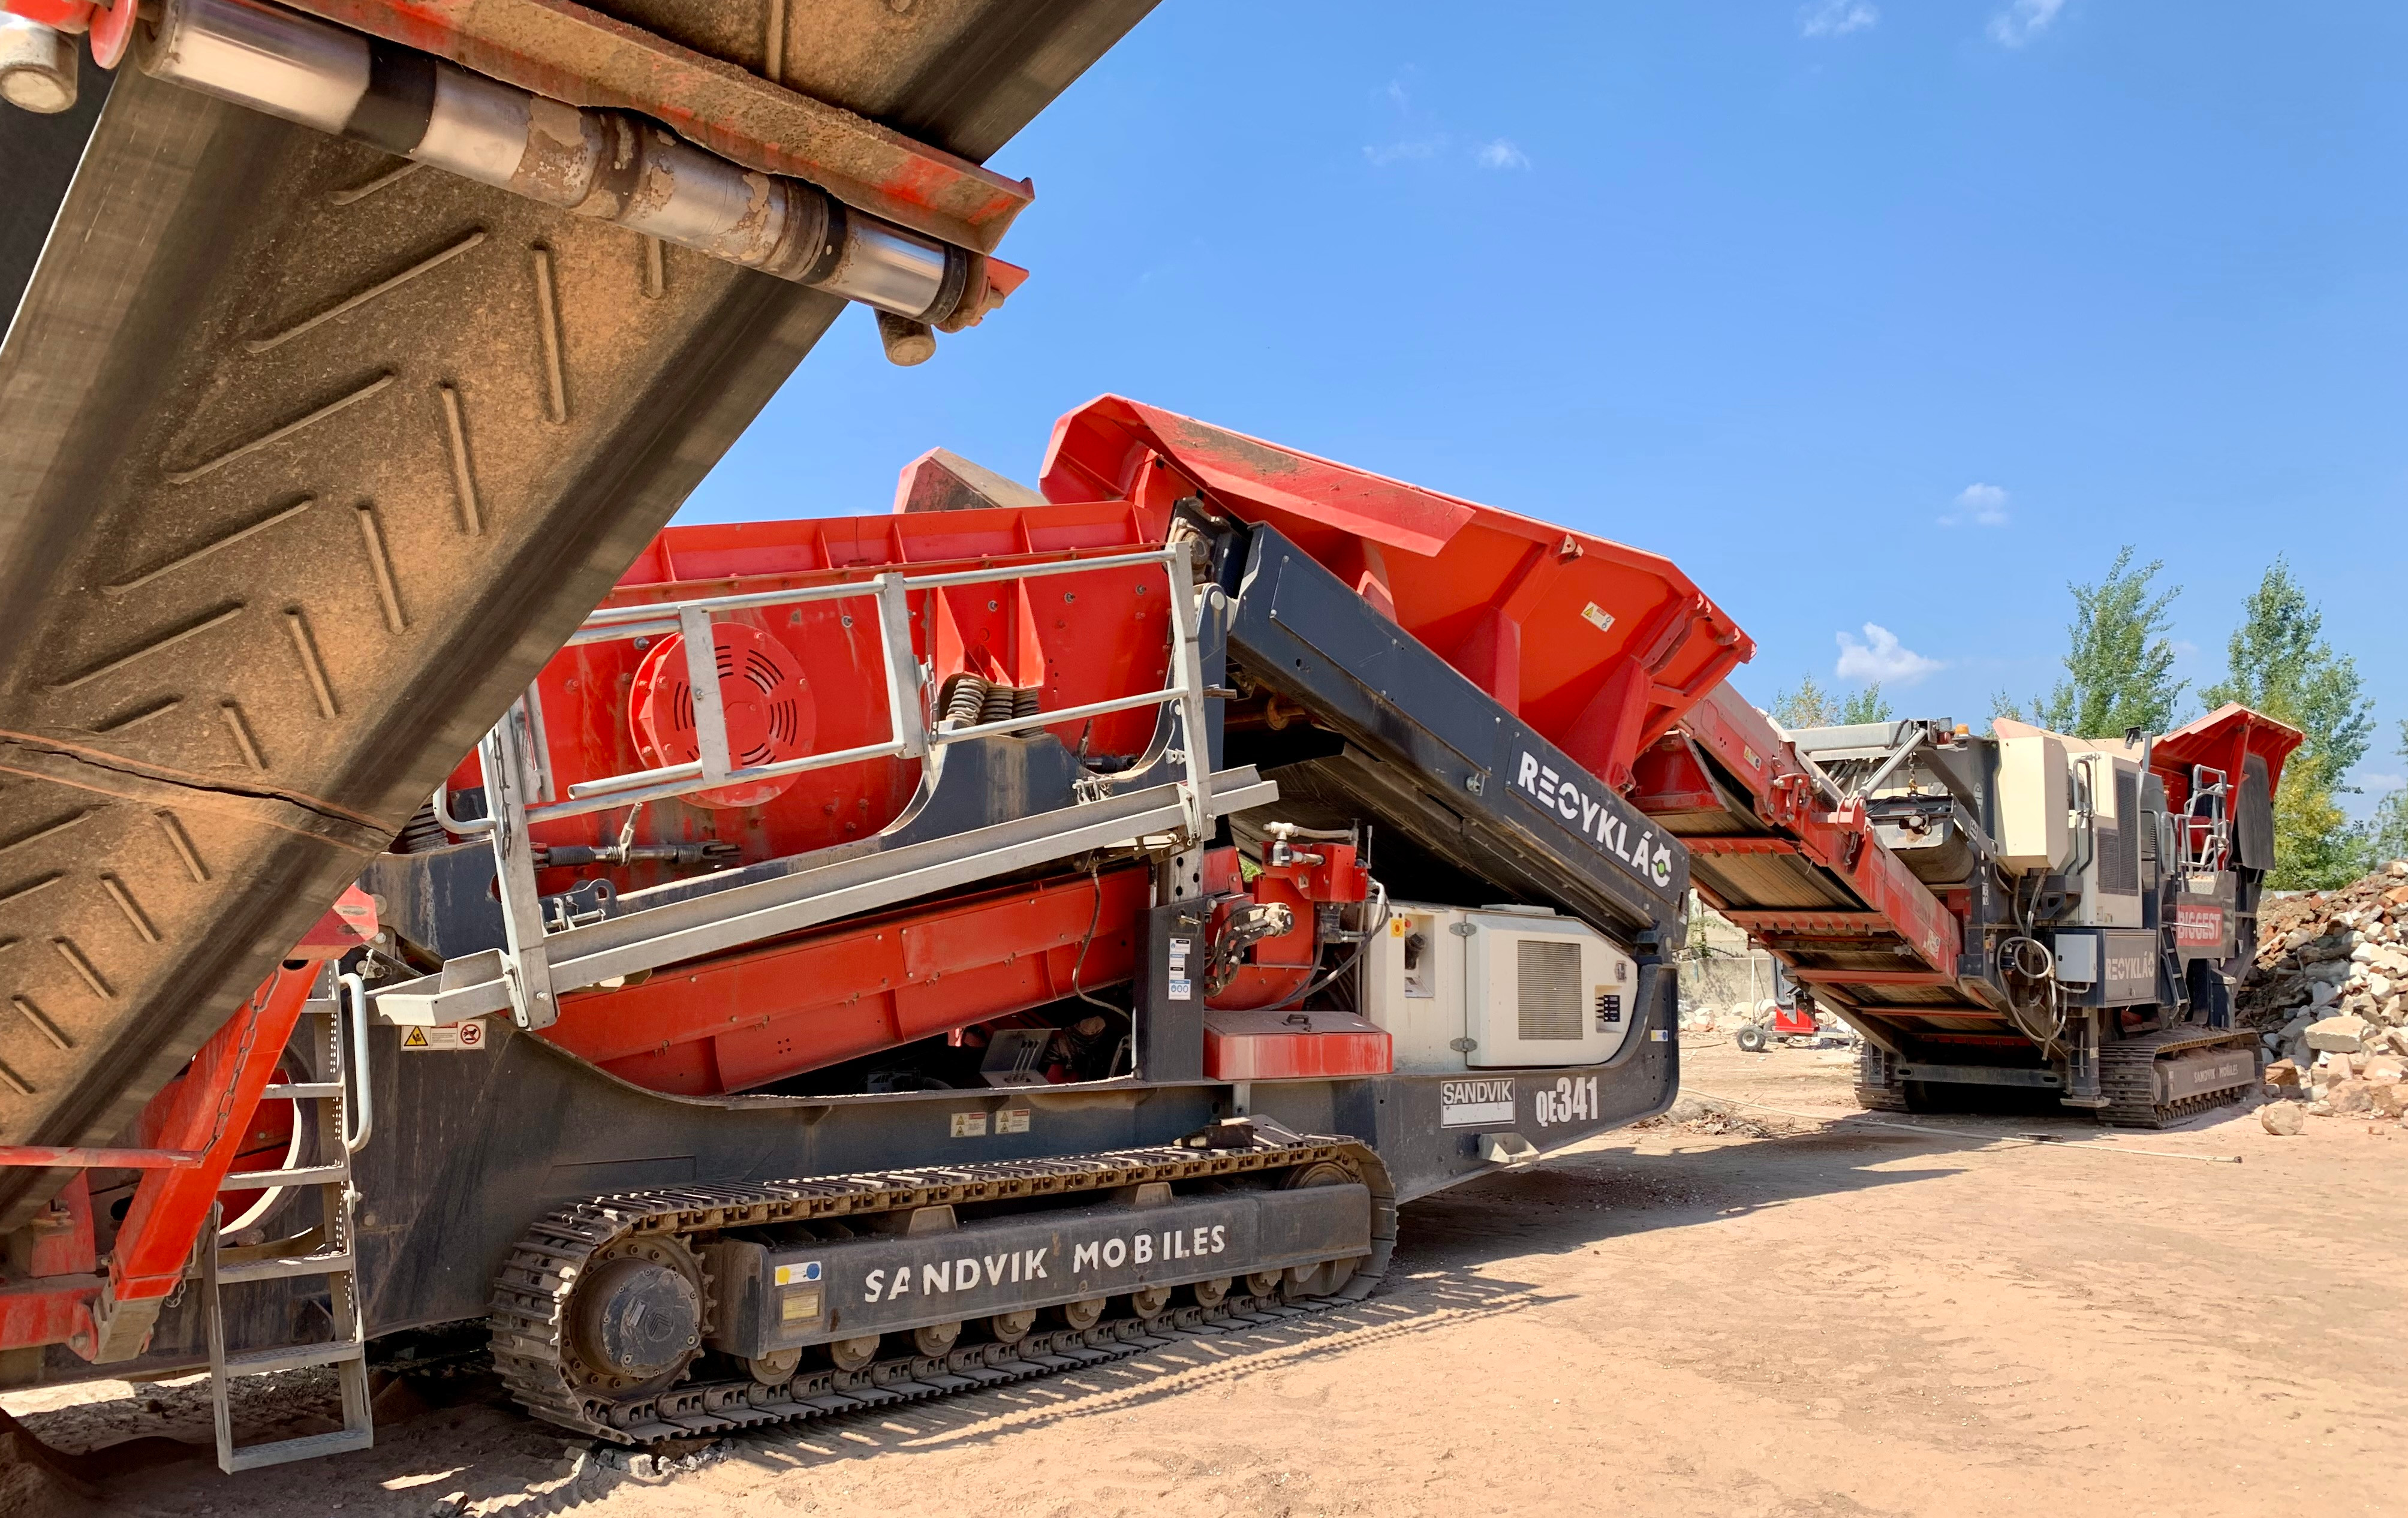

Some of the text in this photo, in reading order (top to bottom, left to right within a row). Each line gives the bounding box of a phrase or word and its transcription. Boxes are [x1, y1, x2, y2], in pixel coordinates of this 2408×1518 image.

[2178, 911, 2221, 940] BIGGEST
[1443, 1080, 1513, 1104] SANDVIK
[865, 1225, 1225, 1303] SANDVIK MOBILES
